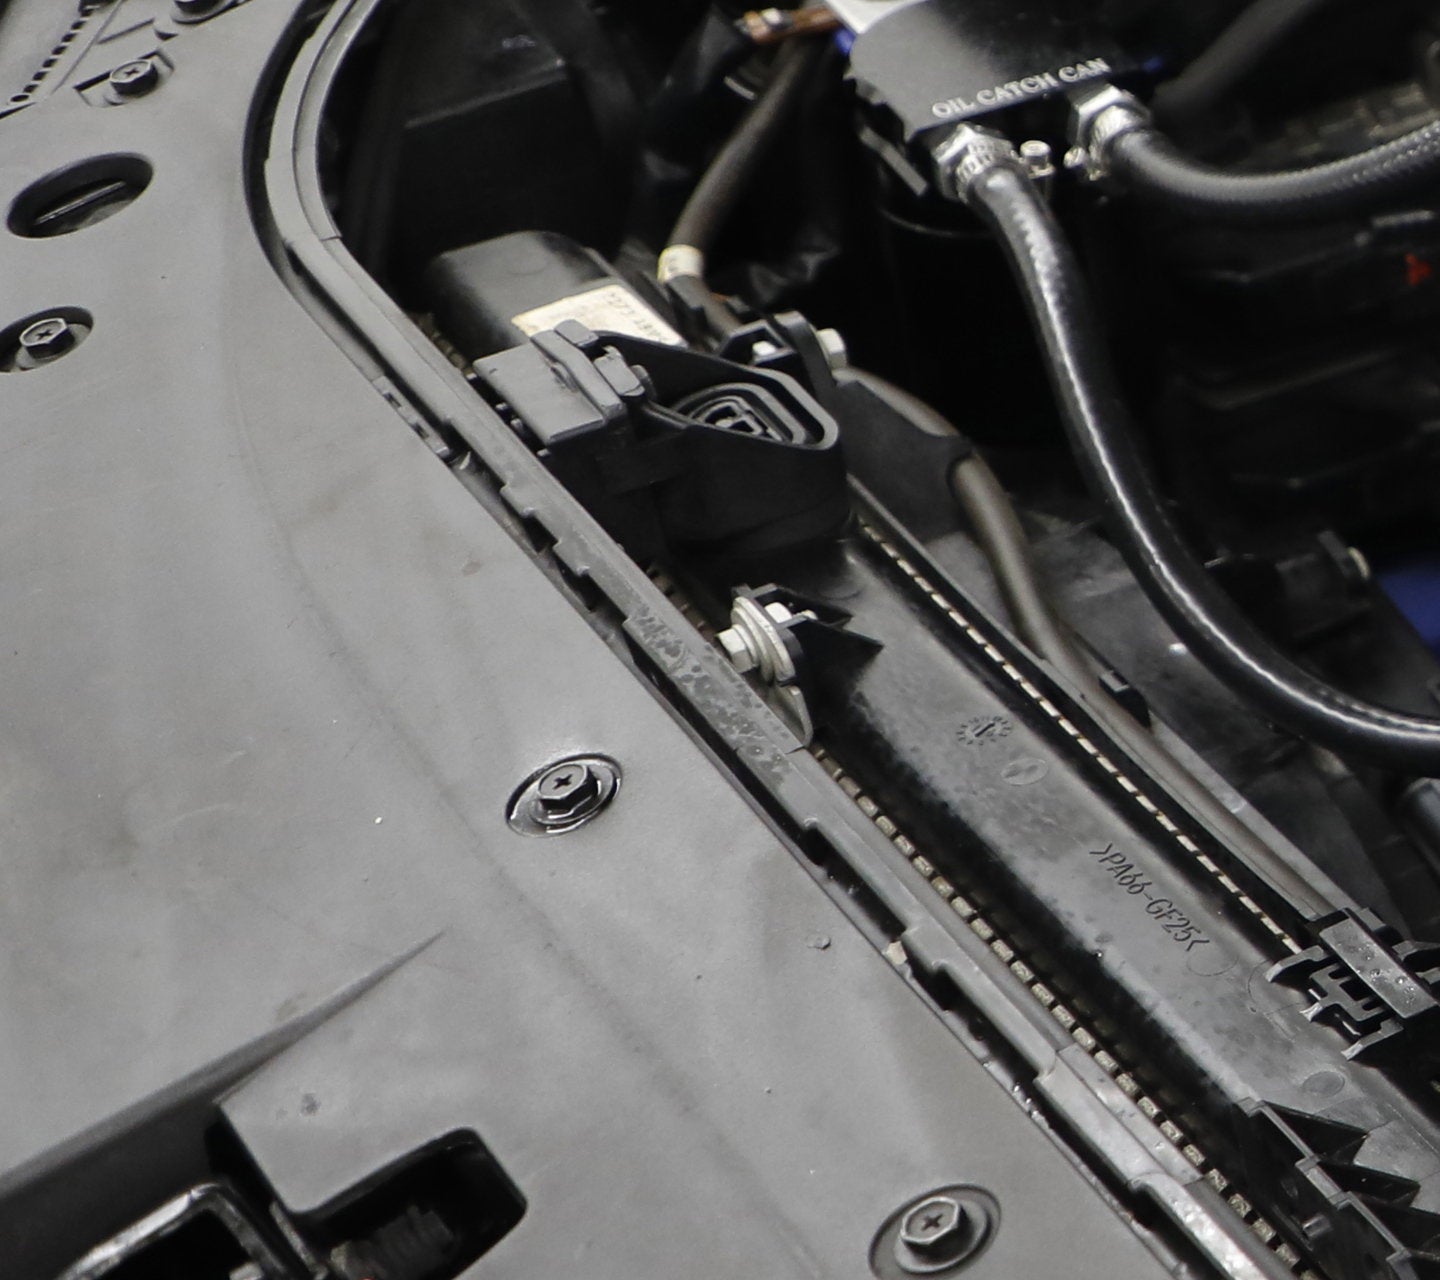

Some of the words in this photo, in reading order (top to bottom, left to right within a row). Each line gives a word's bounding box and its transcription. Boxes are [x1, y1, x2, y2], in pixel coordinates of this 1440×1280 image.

[931, 97, 975, 118] OIL
[976, 72, 1059, 106] CATCH
[1058, 57, 1112, 83] CAN
